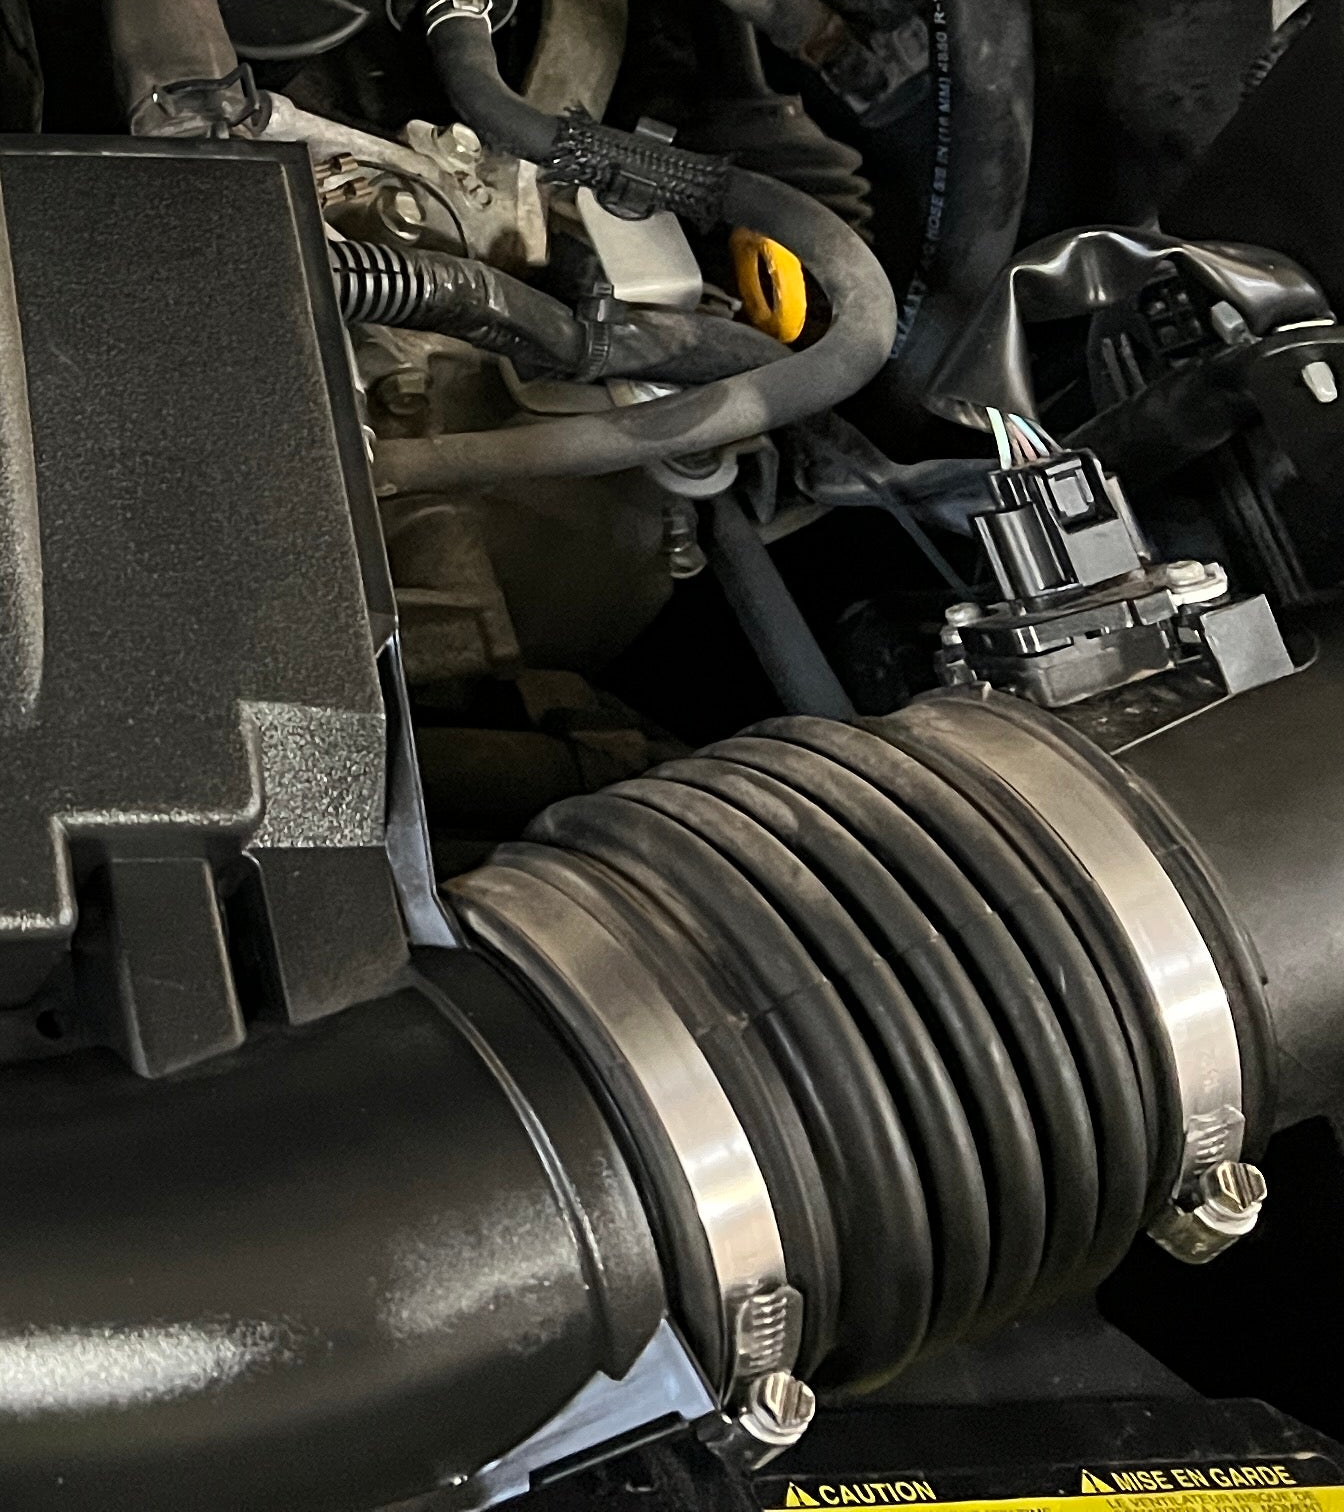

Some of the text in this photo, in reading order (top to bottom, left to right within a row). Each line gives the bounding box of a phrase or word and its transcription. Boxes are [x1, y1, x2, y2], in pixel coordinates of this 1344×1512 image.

[1111, 1465, 1297, 1491] MISE EN GARDE
[818, 1480, 937, 1506] CAUTION
